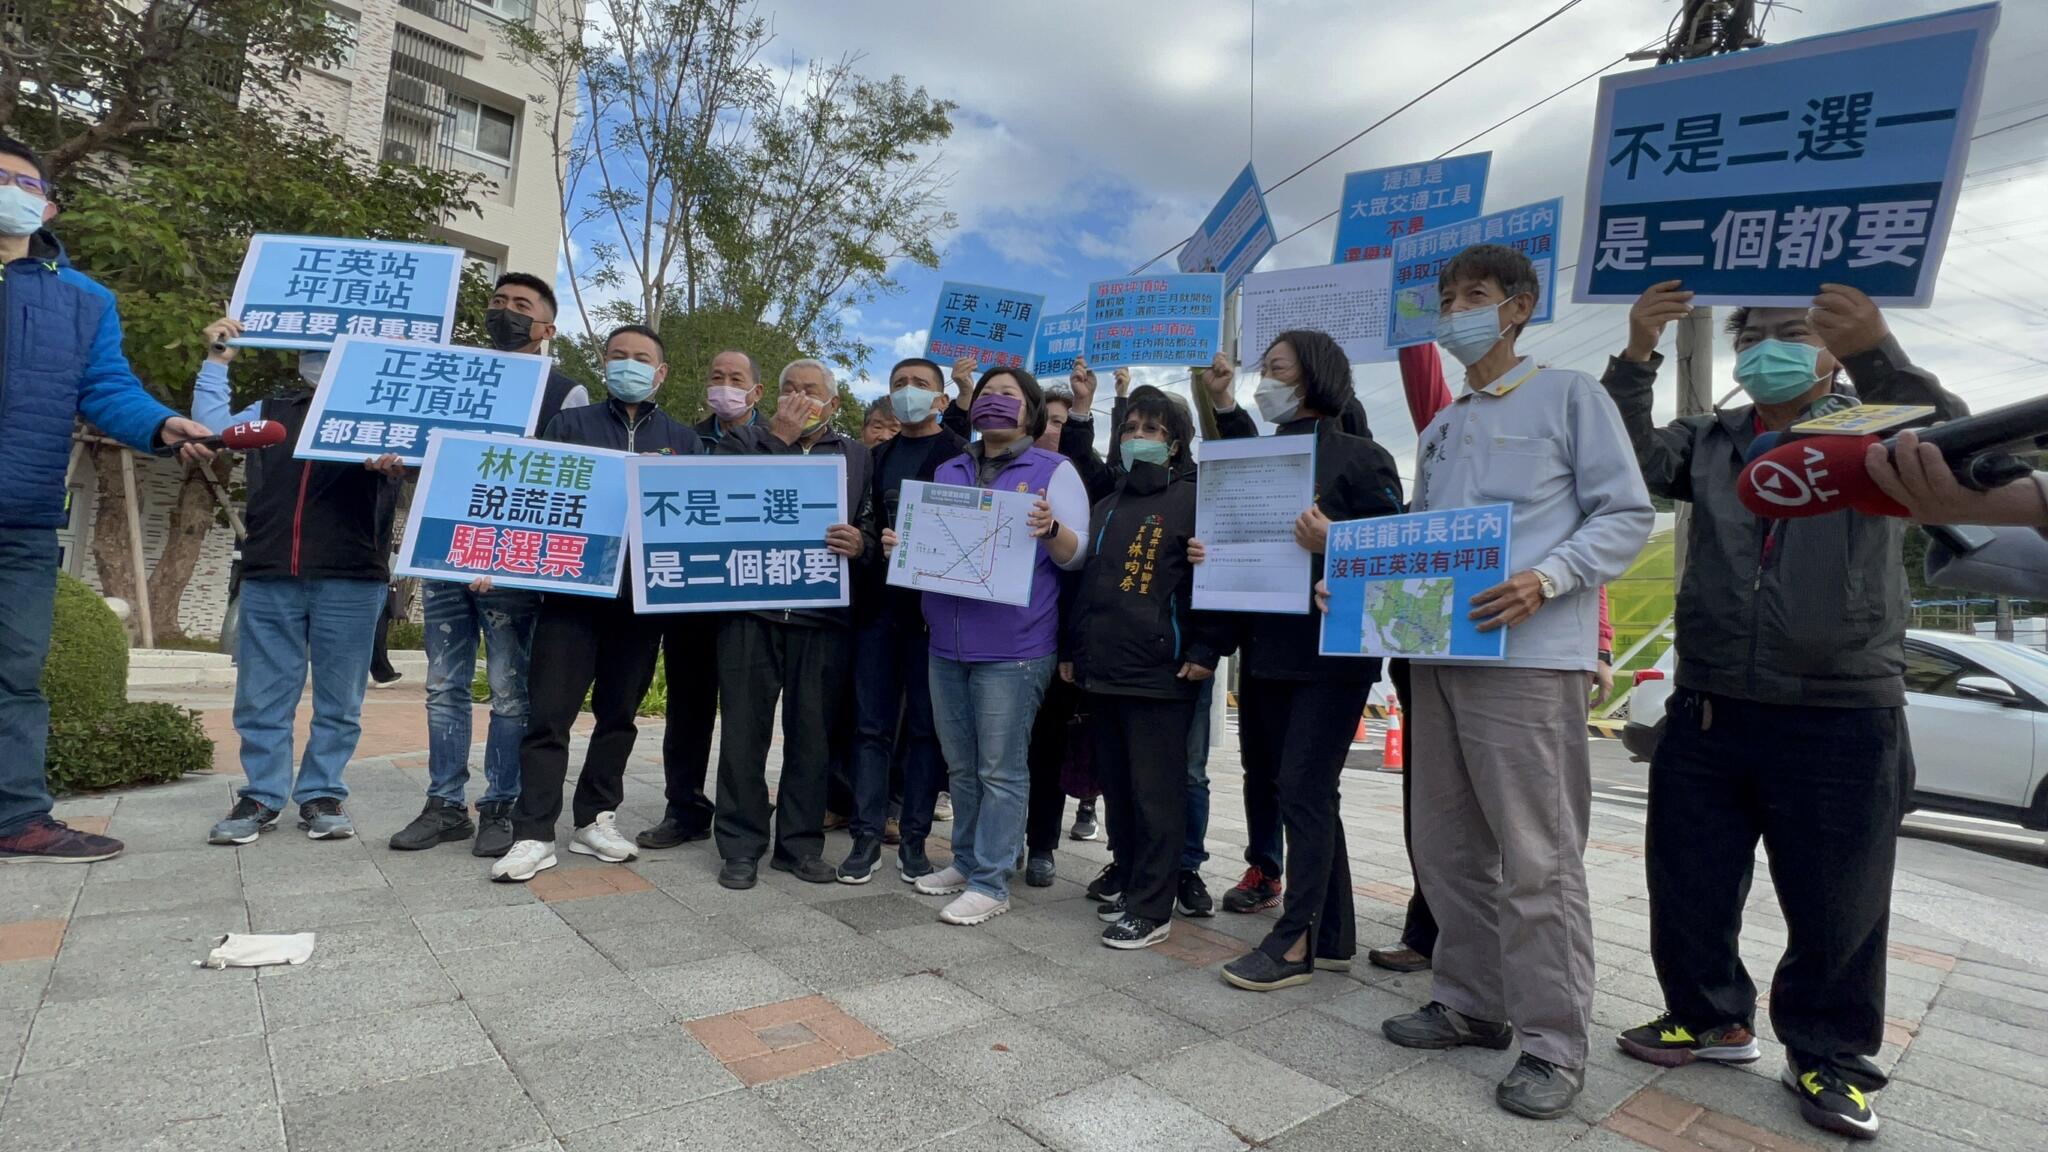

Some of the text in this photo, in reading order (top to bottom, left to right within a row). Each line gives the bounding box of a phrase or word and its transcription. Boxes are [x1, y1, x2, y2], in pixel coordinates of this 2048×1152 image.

[1608, 91, 1957, 180] 不是二選一
[1382, 163, 1443, 192] 捷運是
[1349, 184, 1472, 219] 大眾交通工具
[1386, 216, 1424, 239] 不是
[1397, 207, 1554, 262] 顏莉敏議員任內
[1595, 198, 1933, 272] 是二個都要
[292, 247, 419, 280] 正英站
[285, 274, 413, 310] 坪頂站
[945, 292, 1033, 322] 正英、坪頂
[243, 310, 440, 344] 都重要 很重要
[940, 315, 1023, 342] 不是二選一
[376, 349, 505, 388] 正英站
[366, 379, 497, 421] 坪頂站
[319, 418, 420, 449] 都重要
[477, 446, 596, 491] 林佳龍
[1803, 446, 1840, 502] TTV
[467, 483, 588, 529] 說謊話
[643, 488, 837, 527] 不是二選一
[445, 523, 588, 578] 騙選票
[1332, 512, 1503, 551] 林佳龍市長任內
[647, 548, 840, 589] 是二個都要
[1331, 546, 1500, 578] 沒有正英沒有坪頂
